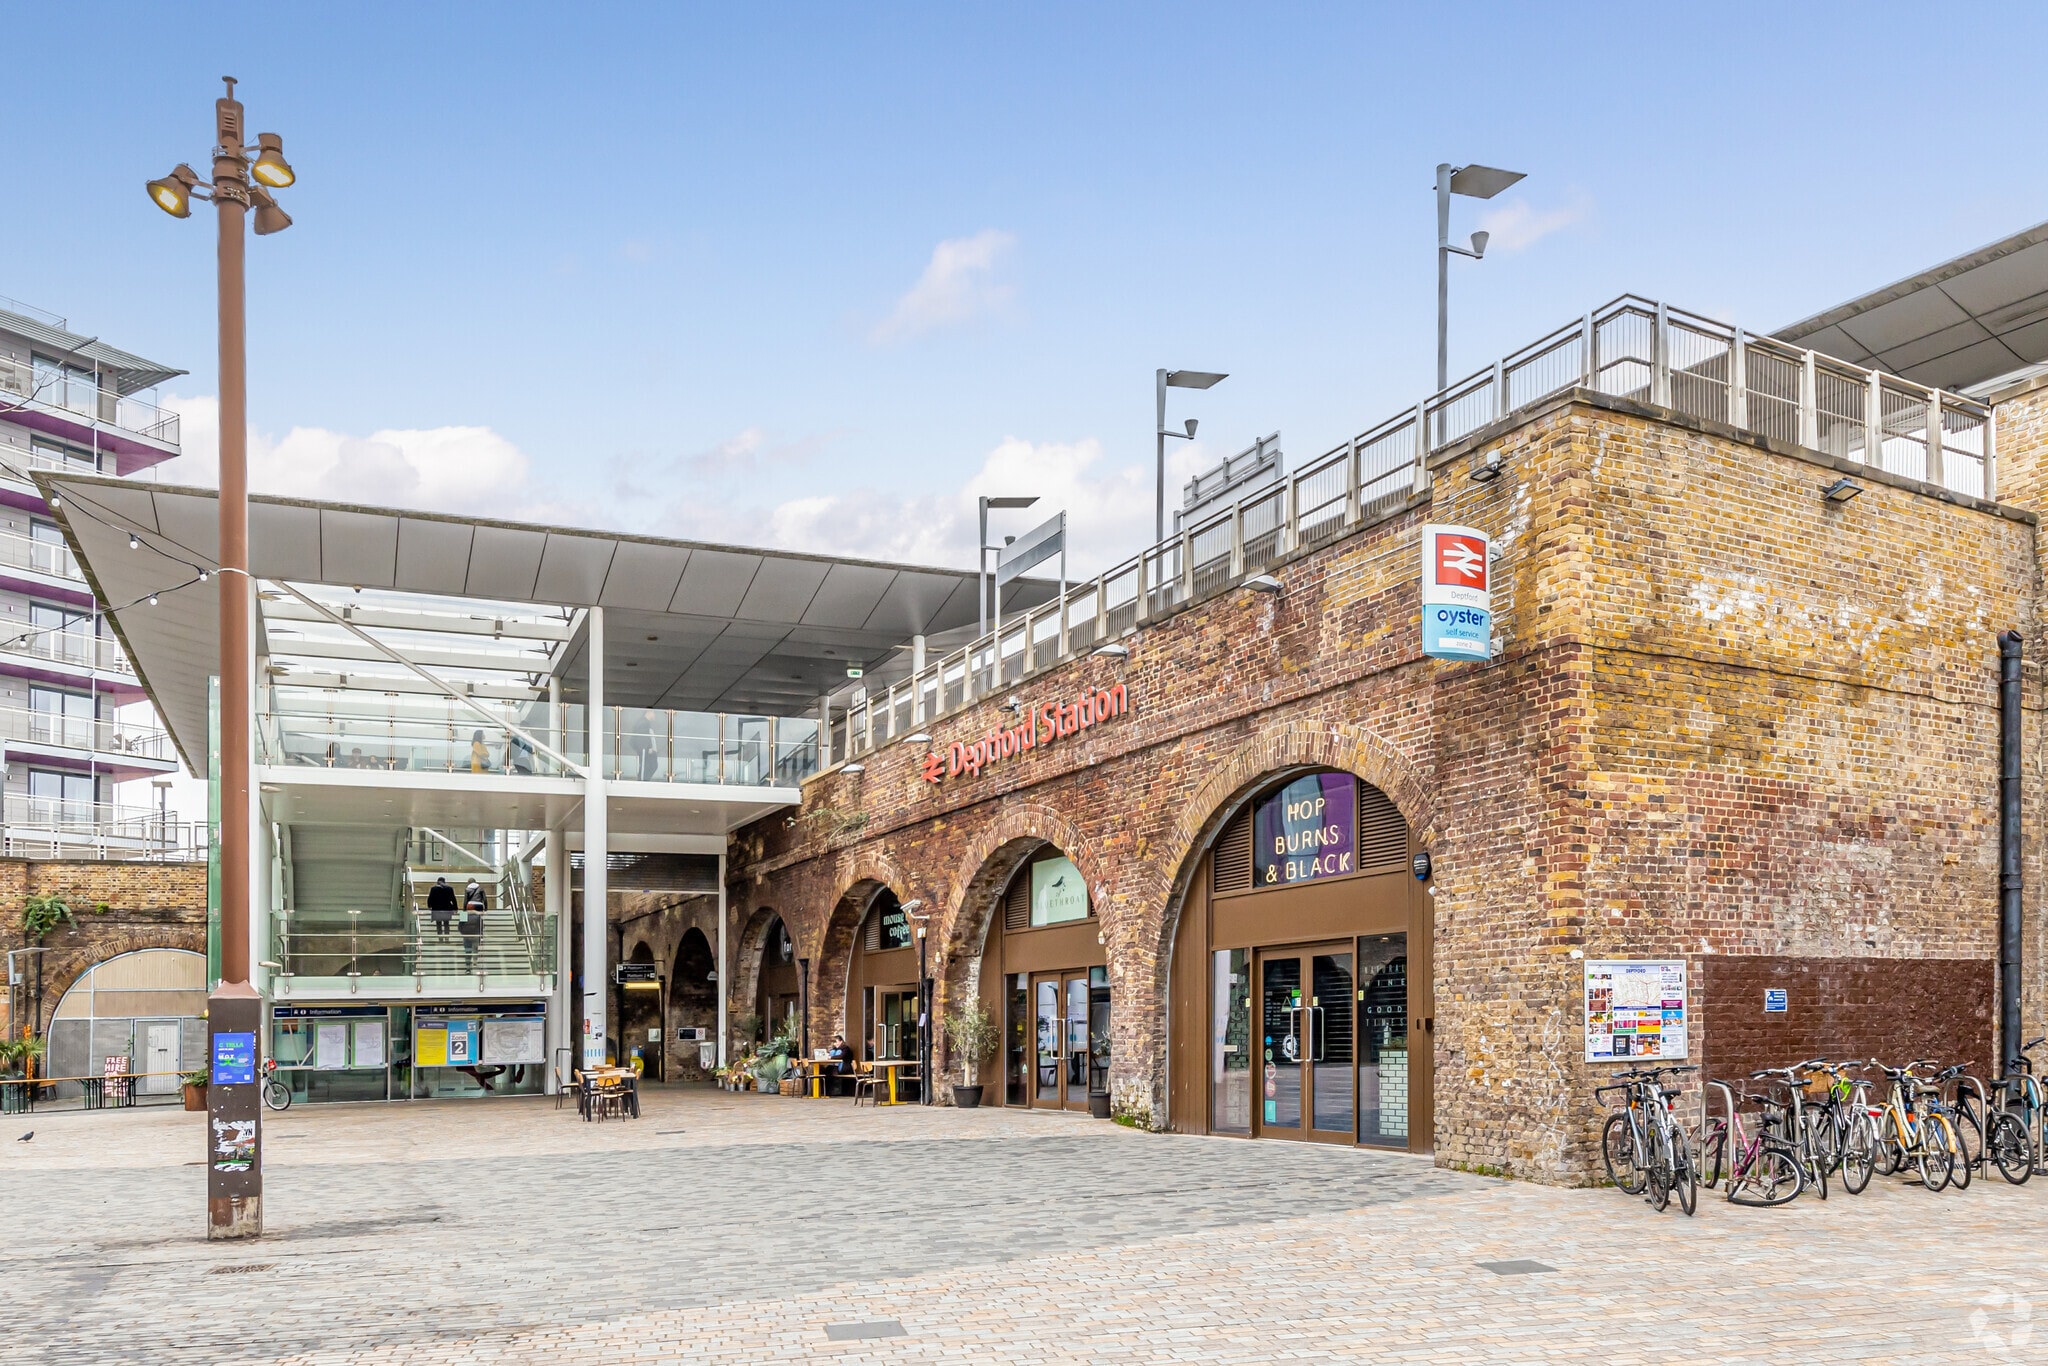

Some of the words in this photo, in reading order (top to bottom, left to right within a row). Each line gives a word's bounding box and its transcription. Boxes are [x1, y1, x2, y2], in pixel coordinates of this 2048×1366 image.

[1451, 591, 1478, 602] Deptford
[1437, 609, 1484, 626] oyster
[1446, 628, 1458, 636] self
[1459, 630, 1479, 639] service
[949, 708, 1037, 778] Deptford
[1040, 683, 1128, 743] Station
[1287, 797, 1325, 823] HOP
[1275, 824, 1339, 855] BURNS
[1265, 864, 1278, 883] &
[1286, 852, 1352, 880] BLACK
[1035, 894, 1085, 910] UETHROAT
[883, 913, 905, 926] mouse
[889, 924, 910, 940] coffee
[1367, 1006, 1402, 1014] GOOD
[454, 1041, 464, 1054] 2
[106, 1056, 128, 1064] FREE
[105, 1063, 127, 1072] HIRE
